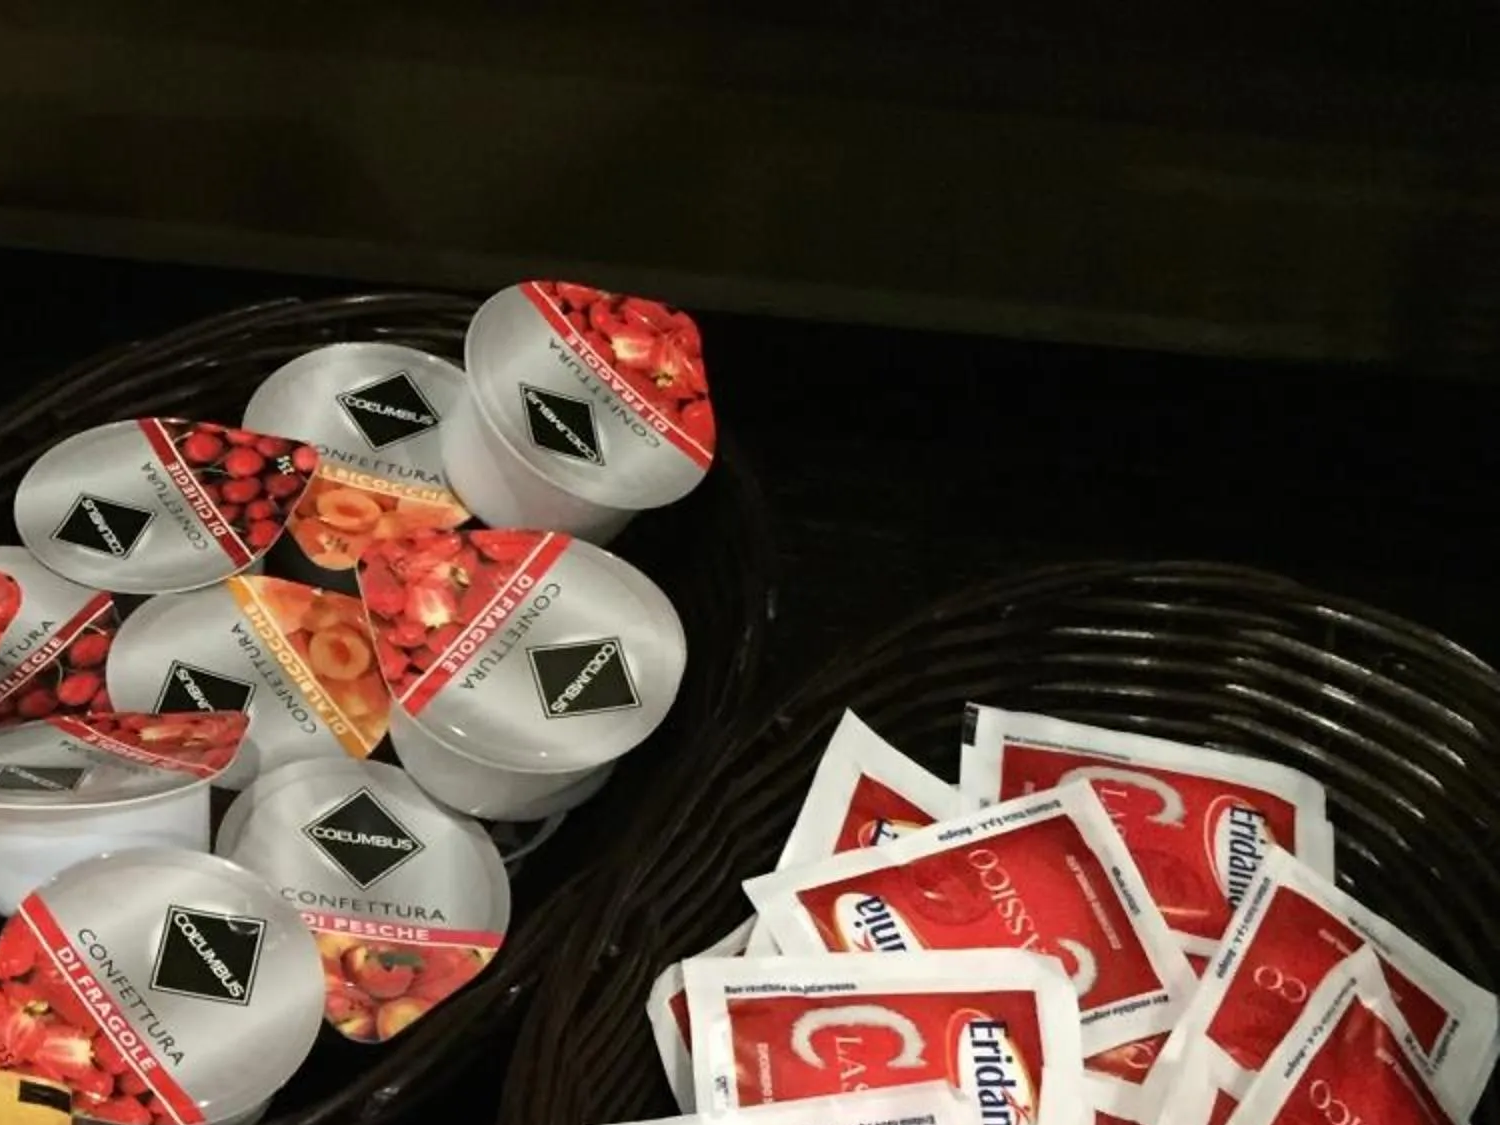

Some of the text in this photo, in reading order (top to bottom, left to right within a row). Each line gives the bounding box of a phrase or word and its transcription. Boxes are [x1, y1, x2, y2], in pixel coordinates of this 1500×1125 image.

[344, 396, 436, 426] COLUMBUS
[548, 336, 661, 449] CONFETTURA
[566, 329, 646, 416] FRAGOLE
[526, 391, 598, 462] COLUMBUS
[82, 499, 126, 557] COLUMBUS
[441, 574, 535, 674] DI FRAGOLE
[460, 583, 561, 690] CONFETTURA
[231, 622, 317, 735] CONFETTURA
[550, 643, 618, 715] COLUMBUS
[311, 824, 415, 852] COLUMBUS
[280, 886, 447, 924] CONFETTURA
[328, 916, 430, 942] PESCHE
[78, 927, 186, 1067] CONFETTURA
[173, 911, 246, 1000] COLUMBUS
[57, 946, 158, 1071] DI FRAGOLE
